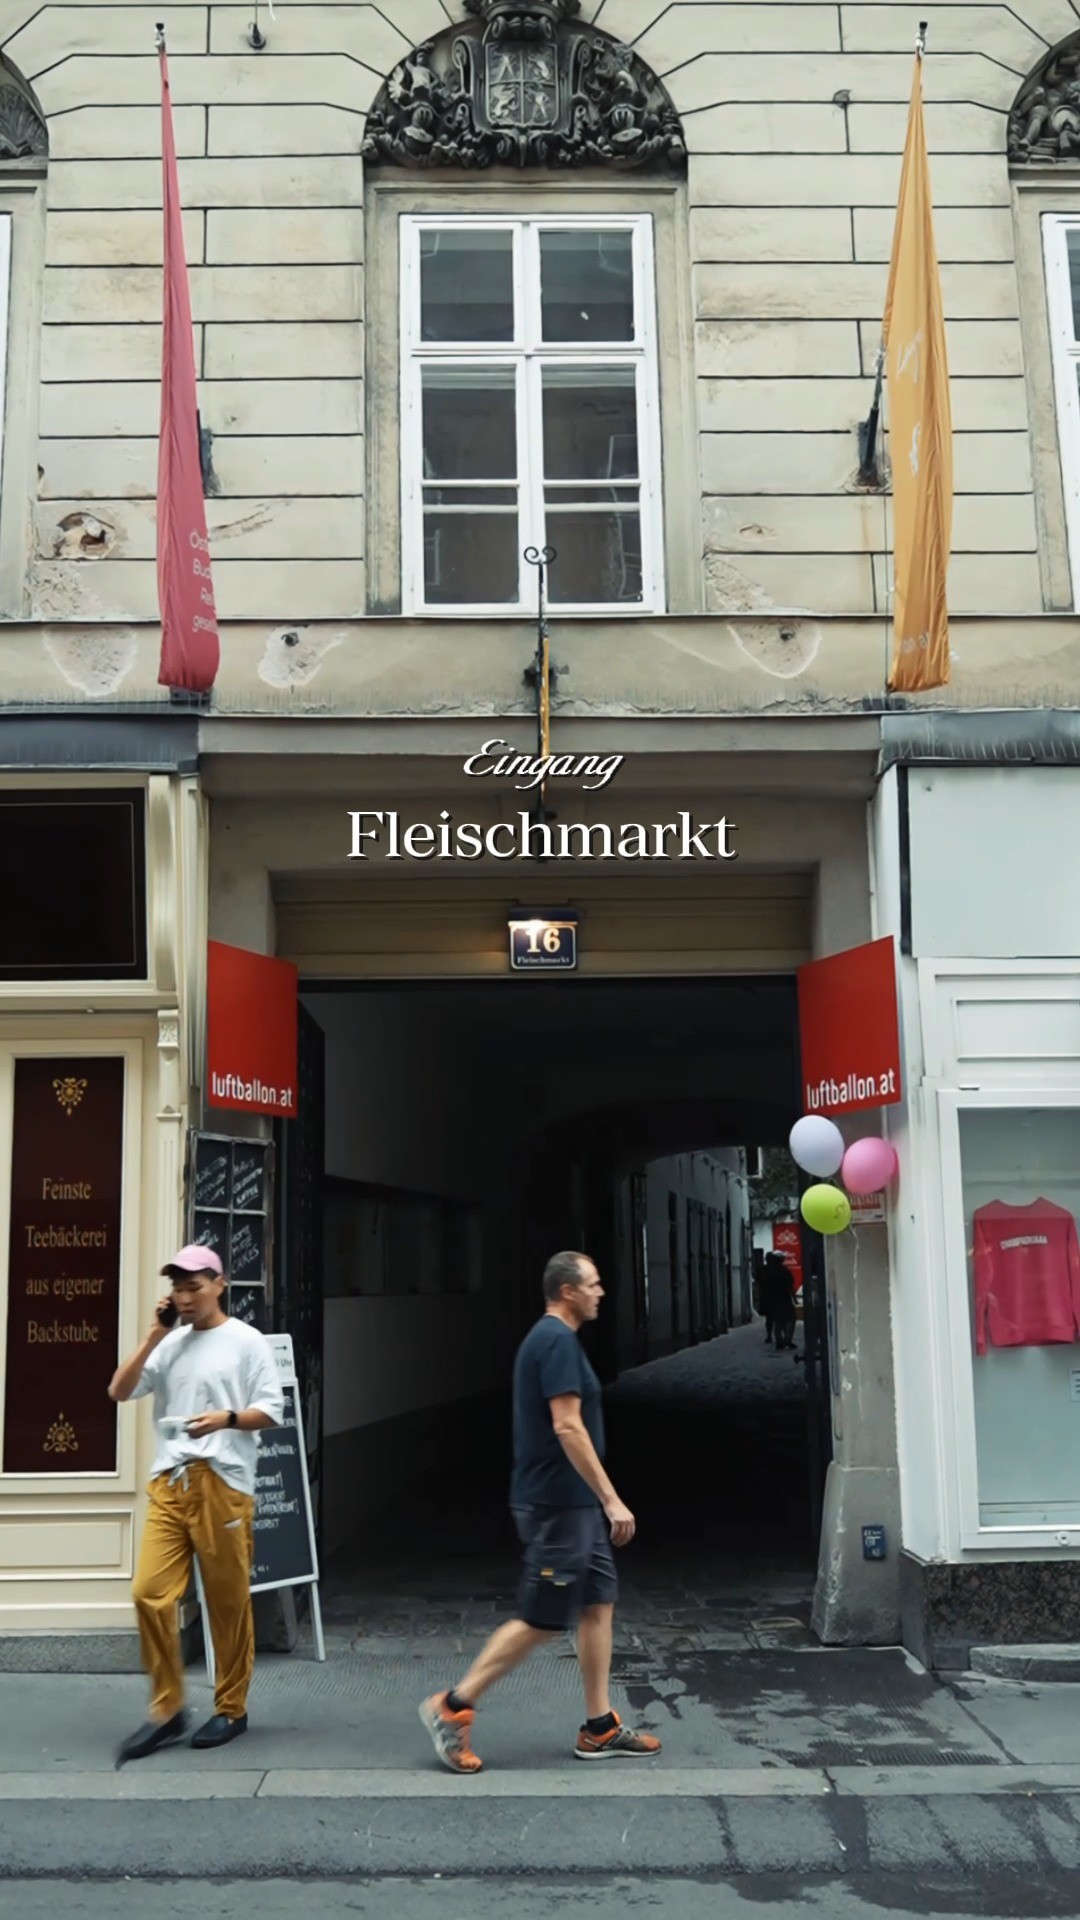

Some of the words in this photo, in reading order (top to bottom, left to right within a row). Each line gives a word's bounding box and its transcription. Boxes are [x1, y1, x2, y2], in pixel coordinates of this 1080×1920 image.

[525, 927, 561, 953] 16
[212, 1071, 293, 1108] luftballon.at
[806, 1067, 896, 1110] luftballon.at
[42, 1177, 92, 1200] Feinste
[25, 1225, 108, 1248] Teebäckerei
[26, 1277, 49, 1296] aus
[53, 1271, 105, 1301] eigener
[27, 1319, 100, 1344] Backstube
